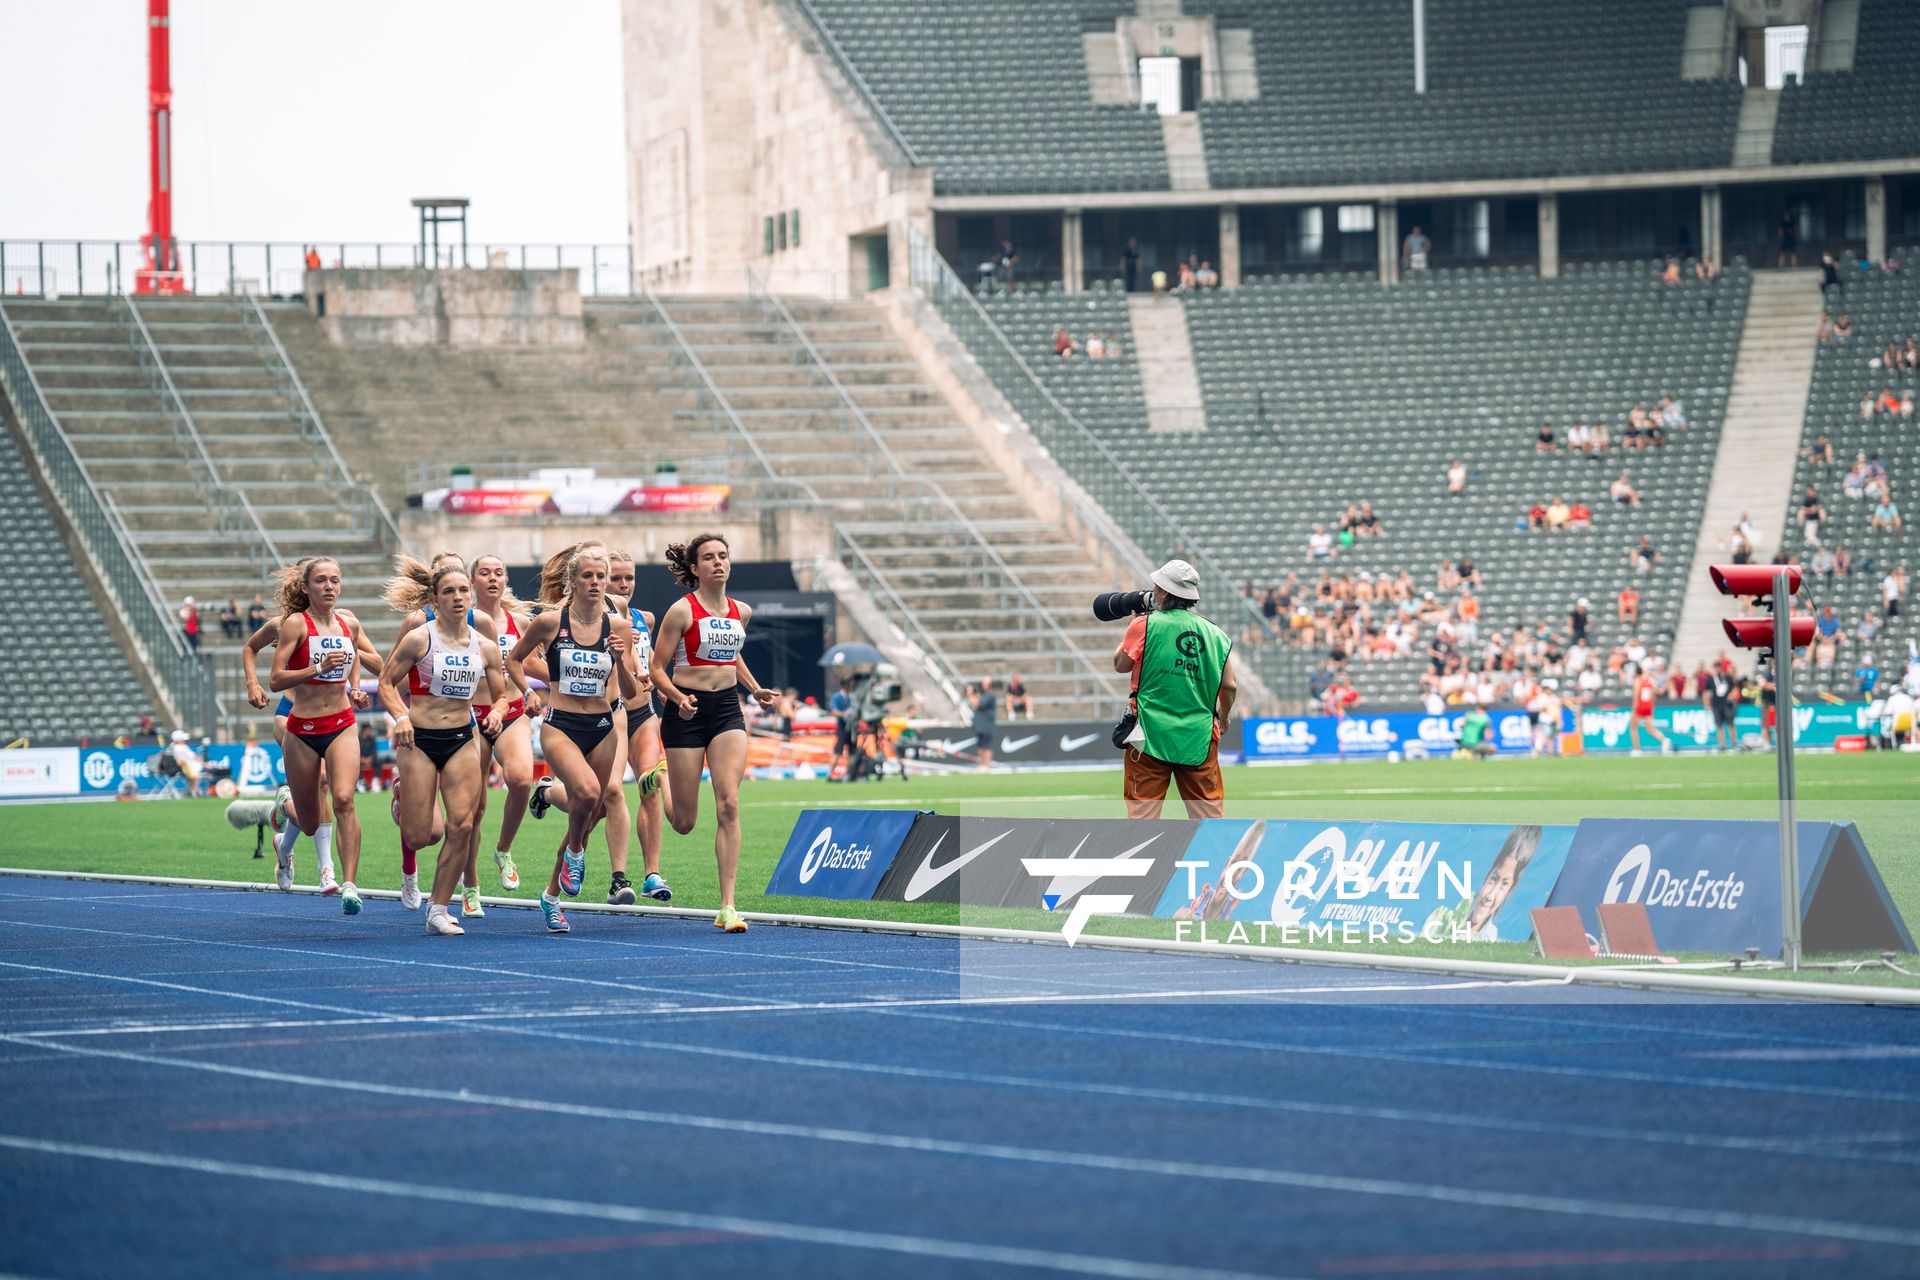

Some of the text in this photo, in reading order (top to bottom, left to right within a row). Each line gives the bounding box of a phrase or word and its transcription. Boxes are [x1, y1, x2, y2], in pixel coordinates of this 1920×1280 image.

[708, 633, 740, 646] HAISCH
[441, 669, 475, 683] STURM
[565, 666, 606, 680] KOLBERG
[822, 843, 845, 869] Das
[842, 843, 872, 870] Erste
[1646, 869, 1689, 907] Das
[1685, 870, 1745, 910] Erste
[1319, 903, 1403, 924] INTERNATIONAL
